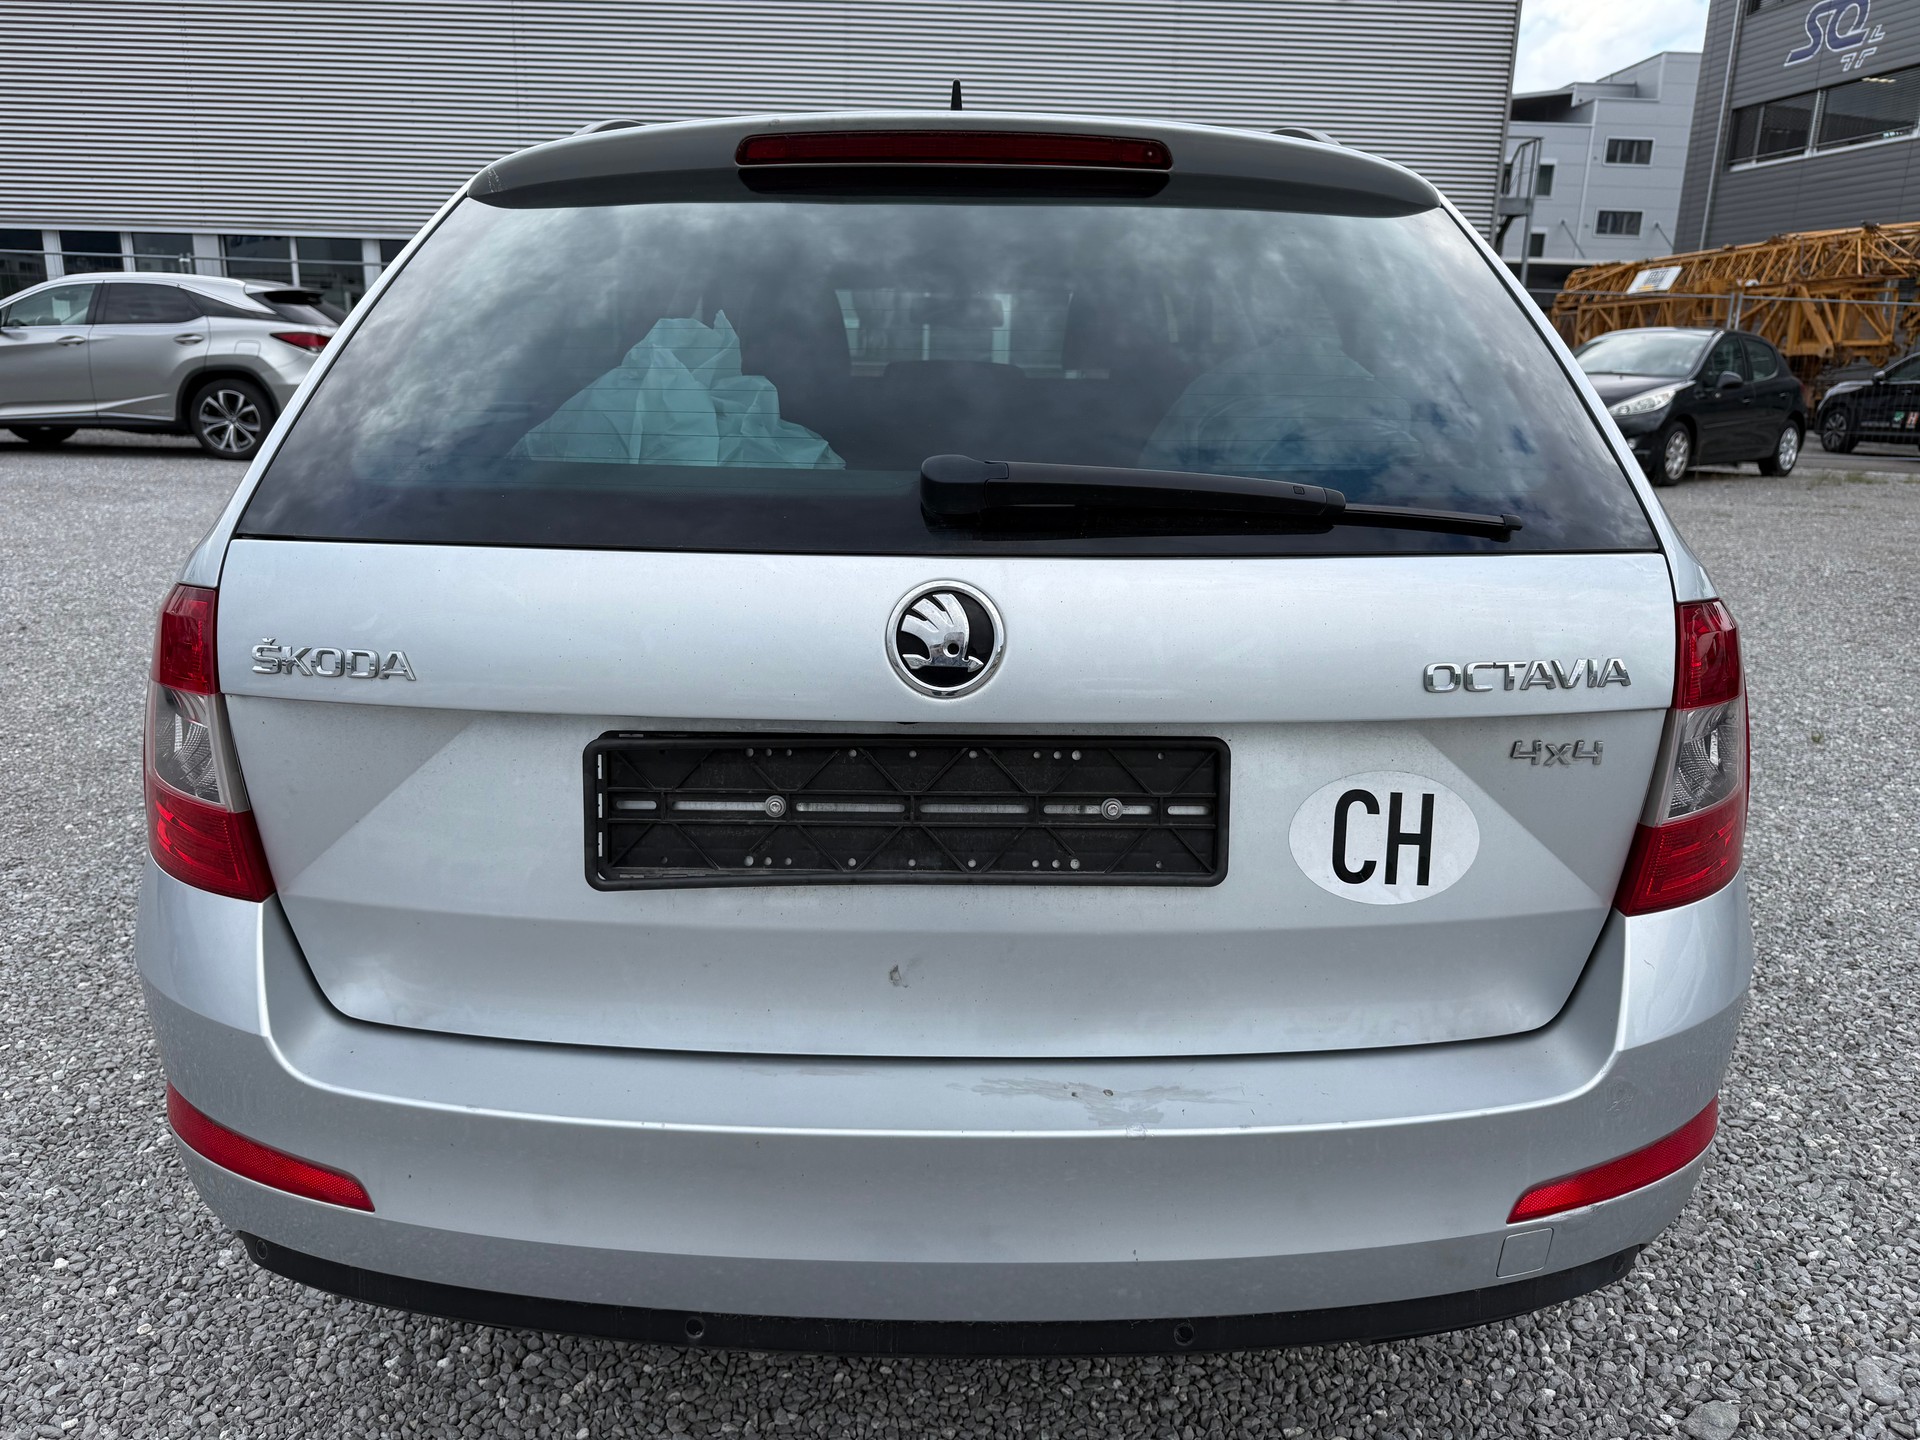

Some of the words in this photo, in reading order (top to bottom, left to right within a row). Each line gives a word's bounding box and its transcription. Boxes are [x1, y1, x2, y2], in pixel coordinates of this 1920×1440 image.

[251, 637, 417, 681] ŠKODA
[1423, 658, 1632, 693] OCTAVIA
[1510, 740, 1604, 767] 4x4
[1332, 788, 1435, 887] CH
